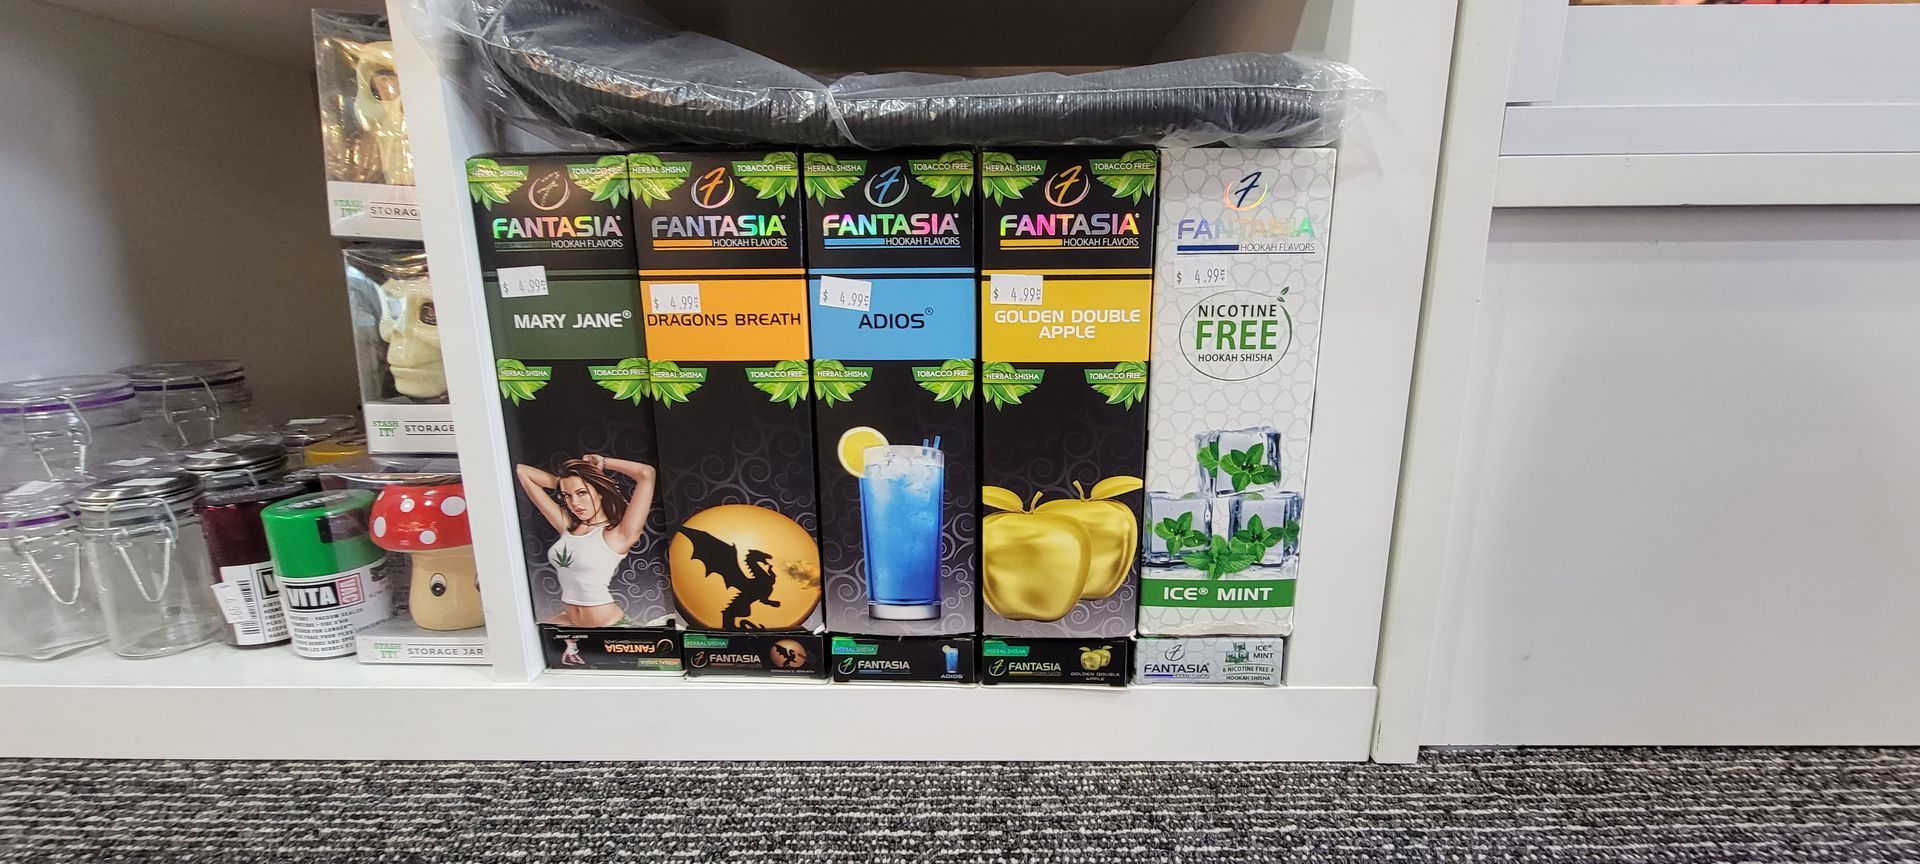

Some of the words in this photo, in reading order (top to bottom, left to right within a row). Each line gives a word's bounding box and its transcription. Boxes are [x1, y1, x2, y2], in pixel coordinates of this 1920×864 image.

[632, 165, 660, 174] HERBAL
[661, 165, 688, 174] SHISHA
[736, 164, 774, 172] TOBACCO
[775, 164, 792, 172] FREE
[807, 164, 835, 173] HERBAL
[836, 164, 863, 172] SHISHA
[913, 163, 951, 172] TOBACCO
[952, 162, 970, 171] FREE
[985, 164, 1015, 172] HERBAL
[1016, 163, 1042, 172] SHISHA
[1094, 162, 1133, 171] TOBACCO
[1134, 162, 1151, 170] FREE
[499, 169, 525, 178] SHISHA
[370, 206, 421, 217] STORAG
[1177, 216, 1315, 240] FANTASIA
[551, 239, 587, 249] HOOKAH
[588, 238, 624, 248] FLAVORS
[712, 238, 749, 247] HOOKAH
[750, 237, 788, 247] FLAVORS
[885, 237, 922, 246] HOOKAH
[923, 236, 960, 246] FLAVORS
[1063, 237, 1101, 247] HOOKAH
[1102, 237, 1139, 246] FLAVORS
[1240, 243, 1277, 252] HOOKAH
[1279, 242, 1315, 251] FLAVORS
[1176, 270, 1183, 285] $
[1194, 268, 1220, 284] 4.99
[503, 281, 509, 295] $
[519, 278, 541, 294] 4.99
[822, 289, 829, 303] $
[839, 291, 864, 307] 4.99
[993, 286, 999, 300] $
[1010, 287, 1036, 301] 4.99
[653, 296, 660, 310] $
[670, 295, 693, 310] 4.99
[994, 309, 1065, 324] GOLDEN
[1071, 308, 1141, 323] DOUBLE
[1198, 304, 1277, 318] NICOTINE
[514, 313, 567, 329] MARY
[647, 313, 728, 326] DRAGONS
[735, 312, 801, 326] BREATH
[1038, 325, 1097, 339] APPLE
[1195, 319, 1278, 350] FREE
[1198, 353, 1238, 362] HOOKAH
[1239, 353, 1273, 362] SHISHA
[630, 368, 646, 376] FREE
[652, 371, 678, 379] HERBAL
[678, 371, 704, 379] SHISHA
[750, 371, 787, 379] TOBACCO
[787, 370, 804, 378] FREE
[817, 370, 843, 378] HERBAL
[843, 370, 869, 378] SHISHA
[916, 369, 953, 377] TOBACCO
[953, 369, 970, 377] FREE
[986, 372, 1013, 380] HERBAL
[1014, 372, 1040, 380] SHISHA
[1089, 372, 1125, 380] TOBACCO
[1126, 371, 1142, 379] FREE
[372, 420, 399, 428] STASH
[404, 424, 456, 432] STORAGE
[378, 428, 395, 437] IT!
[286, 584, 338, 608] VITA
[1216, 587, 1274, 601] MINT
[373, 642, 402, 650] STASH
[604, 643, 656, 654] FANTASIA
[407, 647, 459, 656] STORAGE
[462, 648, 484, 656] JAR
[709, 653, 762, 663] FANTASIA
[857, 660, 911, 670] FANTASIA
[1008, 661, 1062, 672] FANTASIA
[1143, 663, 1210, 674] FANTASIA
[1227, 665, 1255, 673] NICOTINE
[1255, 665, 1271, 673] FREE
